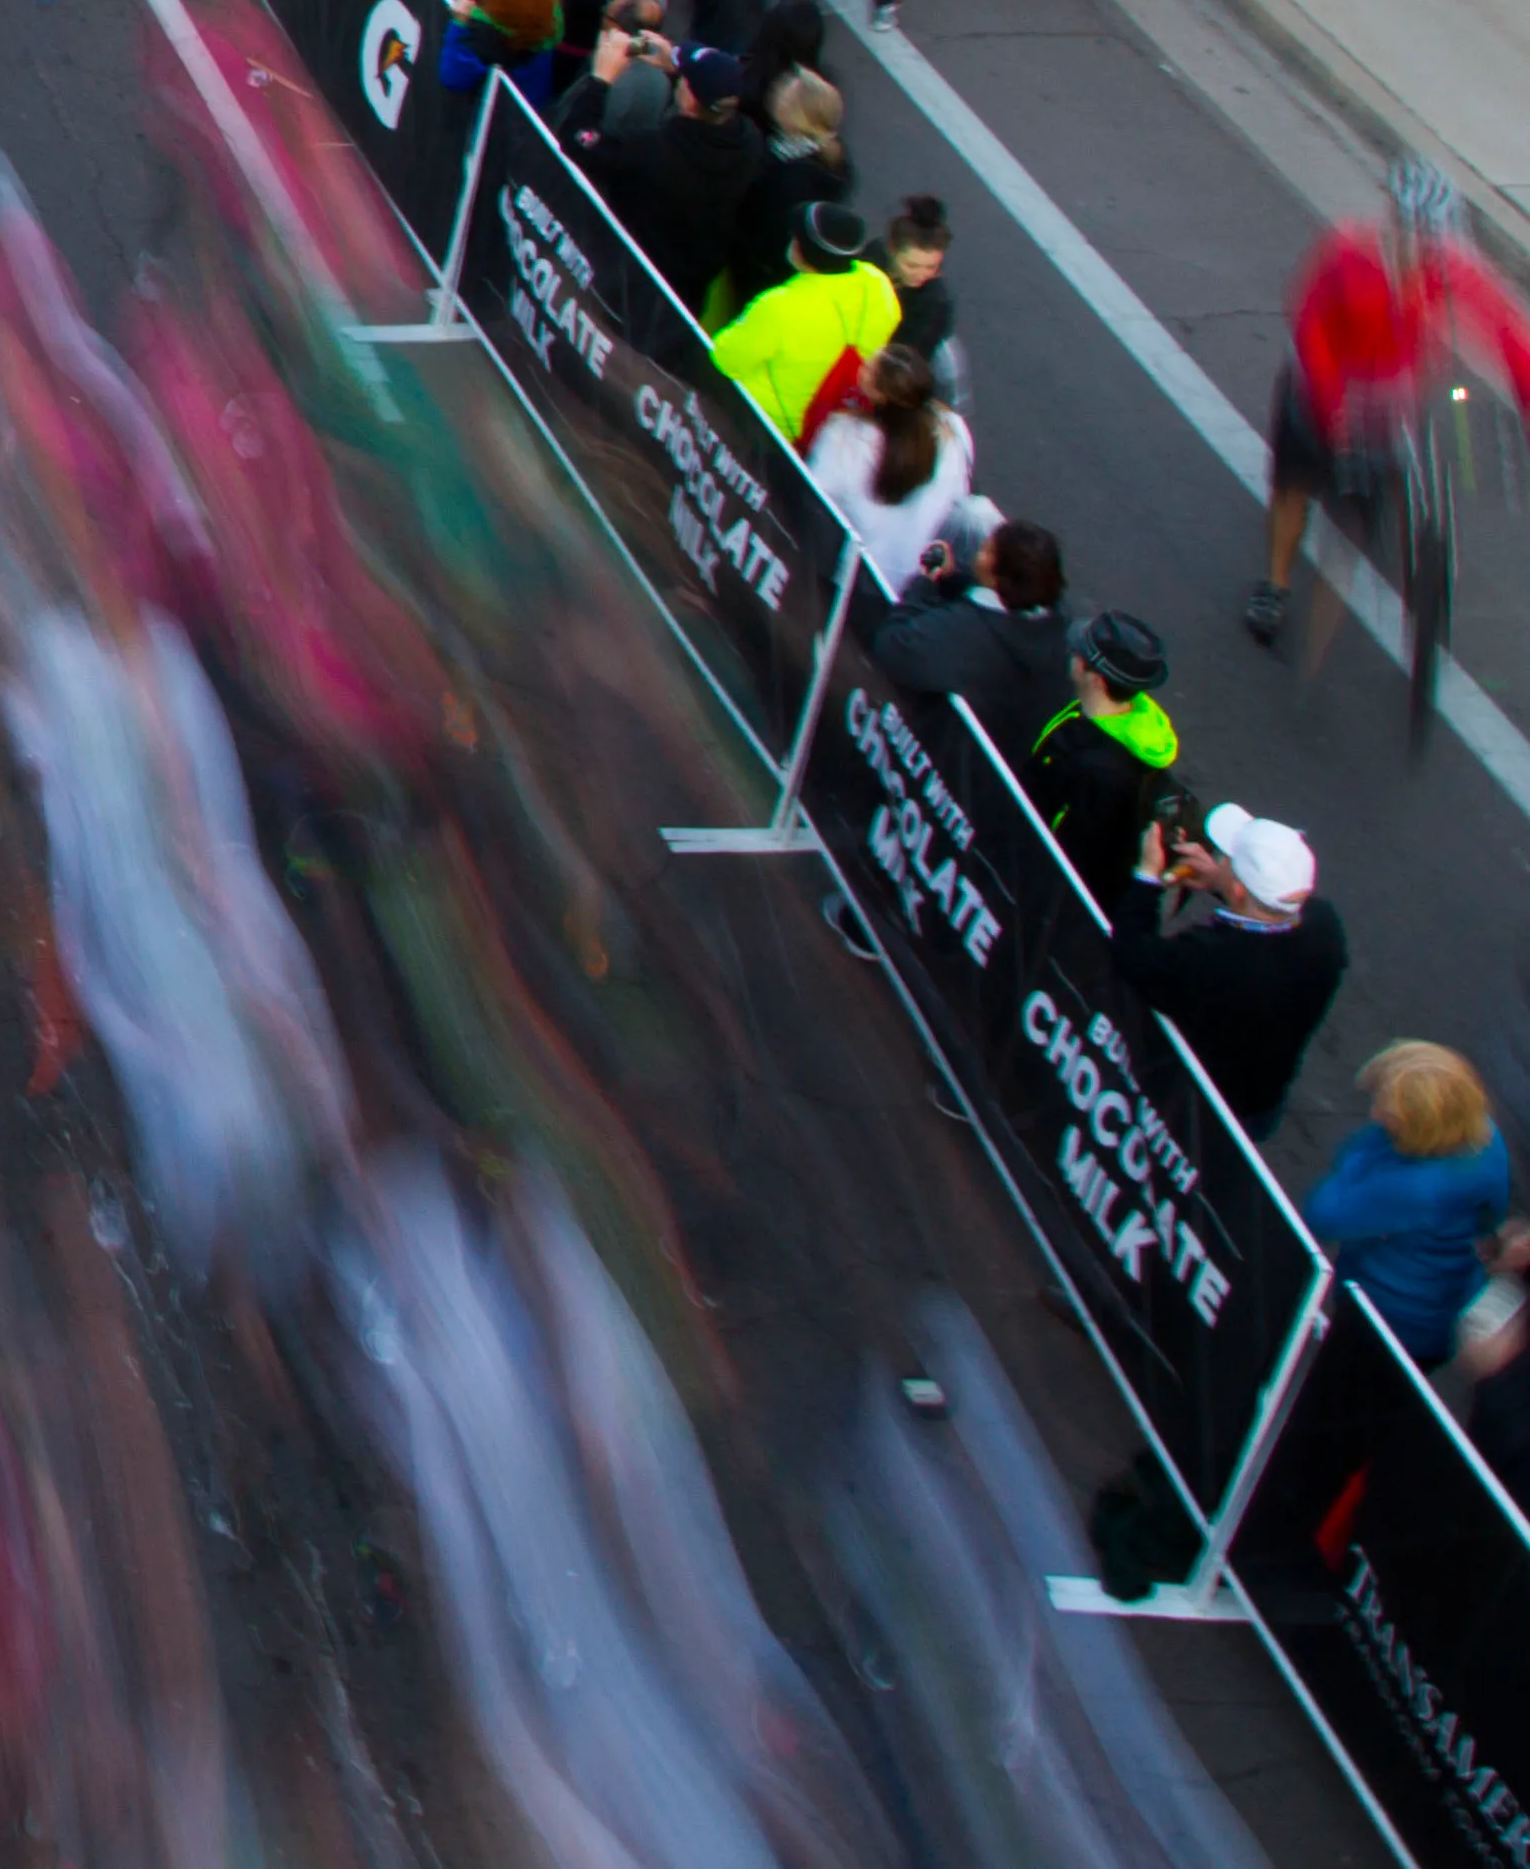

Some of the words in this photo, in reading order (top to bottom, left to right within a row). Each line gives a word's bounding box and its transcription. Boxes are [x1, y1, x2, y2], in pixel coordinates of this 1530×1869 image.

[497, 183, 615, 380] COCOLATE
[634, 383, 790, 612] CHOCOLATE
[683, 389, 720, 454] BLT
[712, 442, 769, 513] WITH
[844, 686, 1003, 970] CHOLATE
[880, 701, 933, 780] BUILT
[922, 768, 977, 852] WITH
[867, 803, 926, 938] MIK
[1021, 989, 1233, 1330] CHOCOATE
[1056, 1124, 1160, 1284] MILK
[1136, 1094, 1200, 1196] WITH
